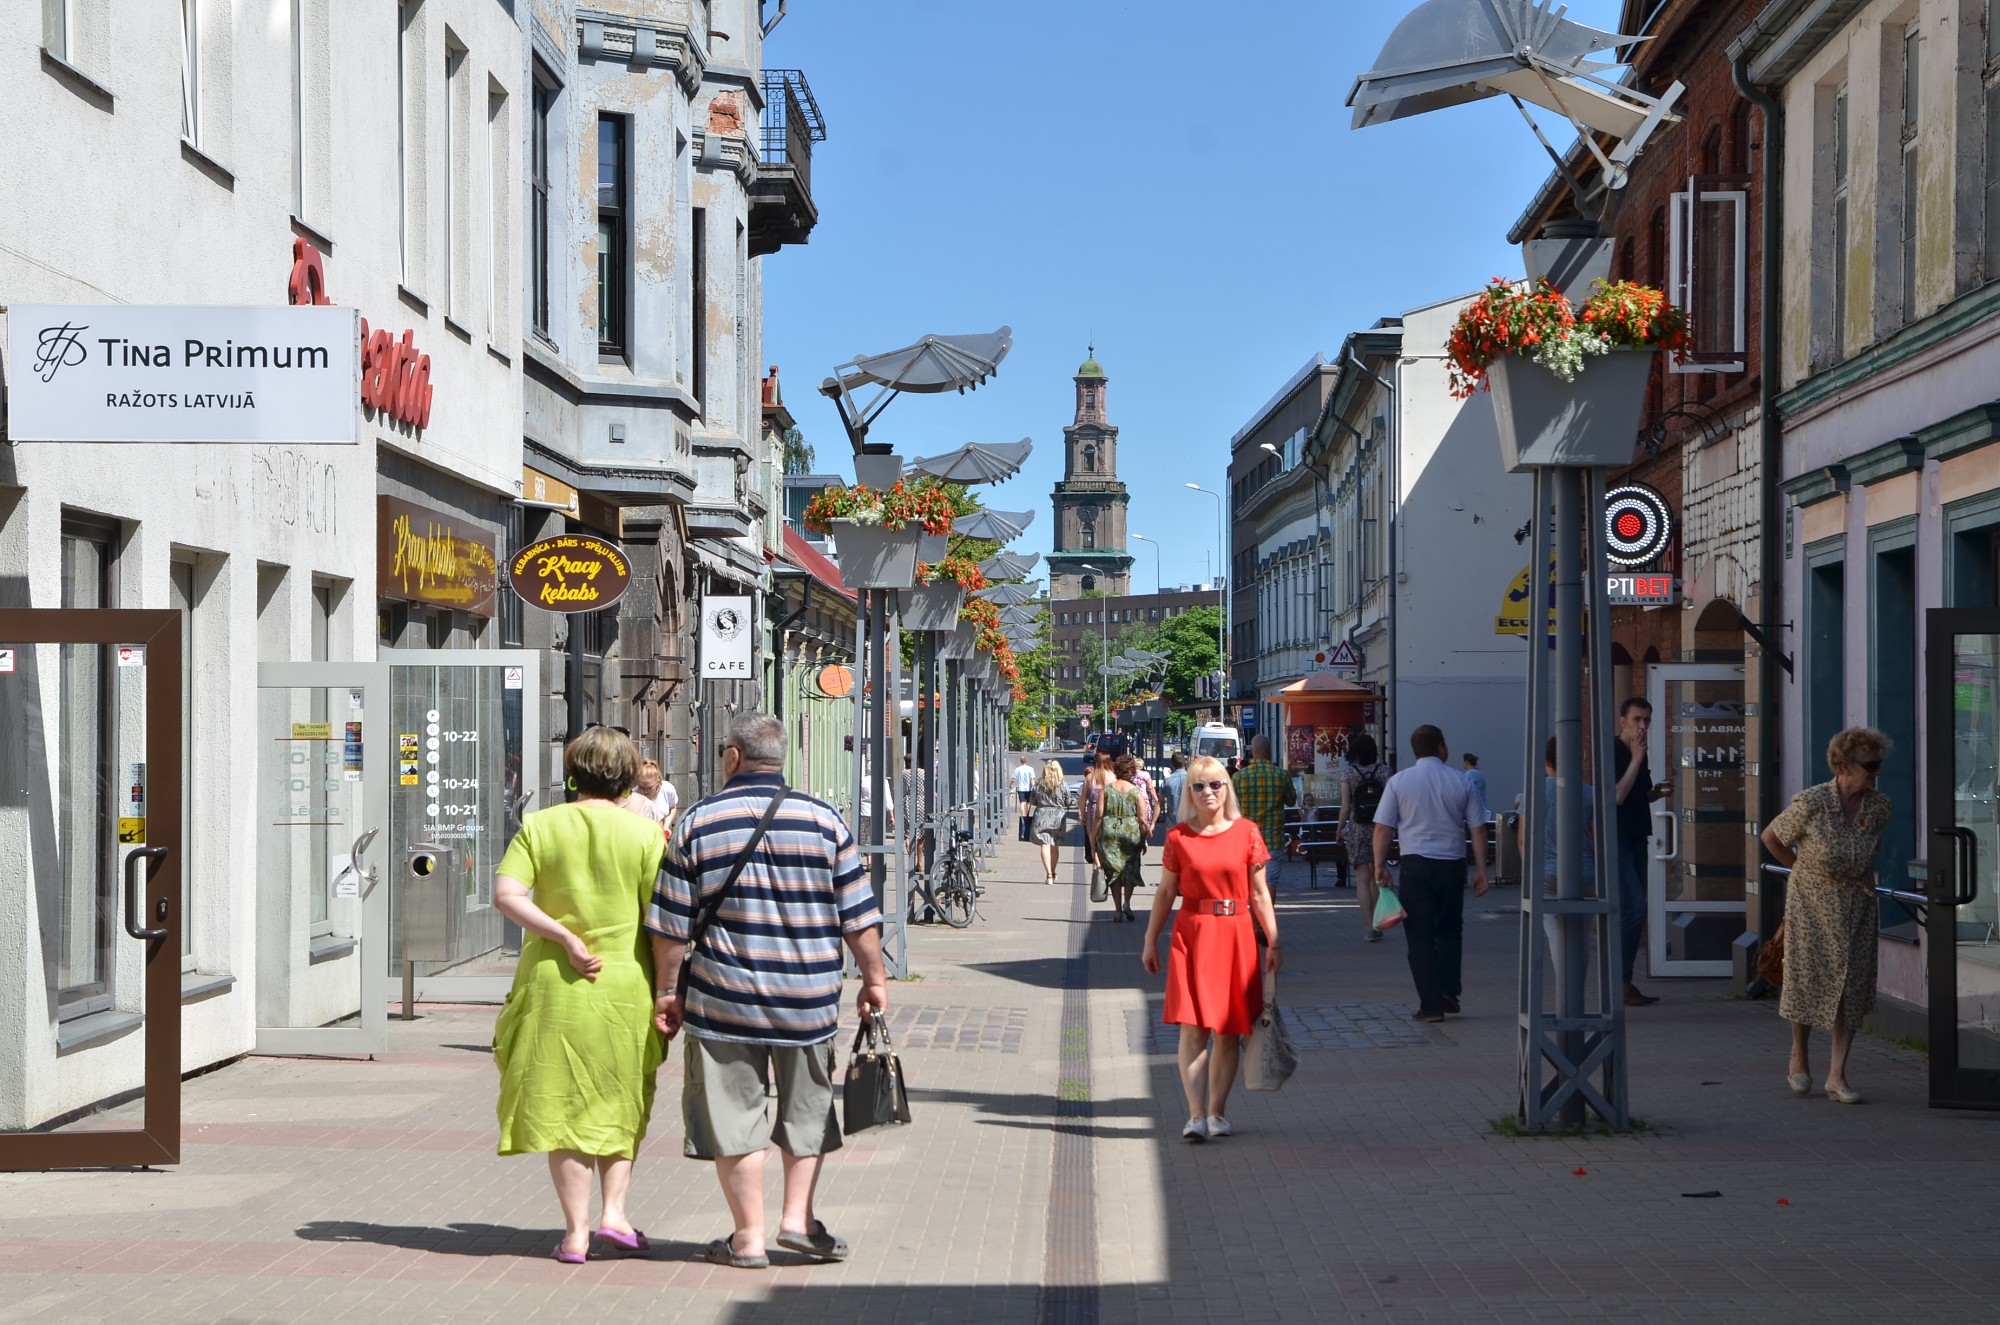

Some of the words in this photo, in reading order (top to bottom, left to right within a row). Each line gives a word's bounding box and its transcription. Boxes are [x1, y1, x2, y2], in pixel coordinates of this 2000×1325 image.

[106, 389, 178, 408] RAŽOTS
[184, 391, 256, 409] LATVIJĀ
[557, 537, 579, 548] BĀRS
[607, 551, 627, 577] KLUBS
[537, 555, 602, 582] Kracy
[1607, 576, 1672, 596] PTIBET
[540, 582, 600, 605] kebabs
[1340, 652, 1349, 661] M
[708, 661, 745, 670] CAFE
[442, 731, 478, 742] 10-22
[443, 778, 480, 789] 10-24
[443, 805, 478, 815] 10-21
[423, 824, 435, 832] SIA
[457, 824, 484, 834] Groups
